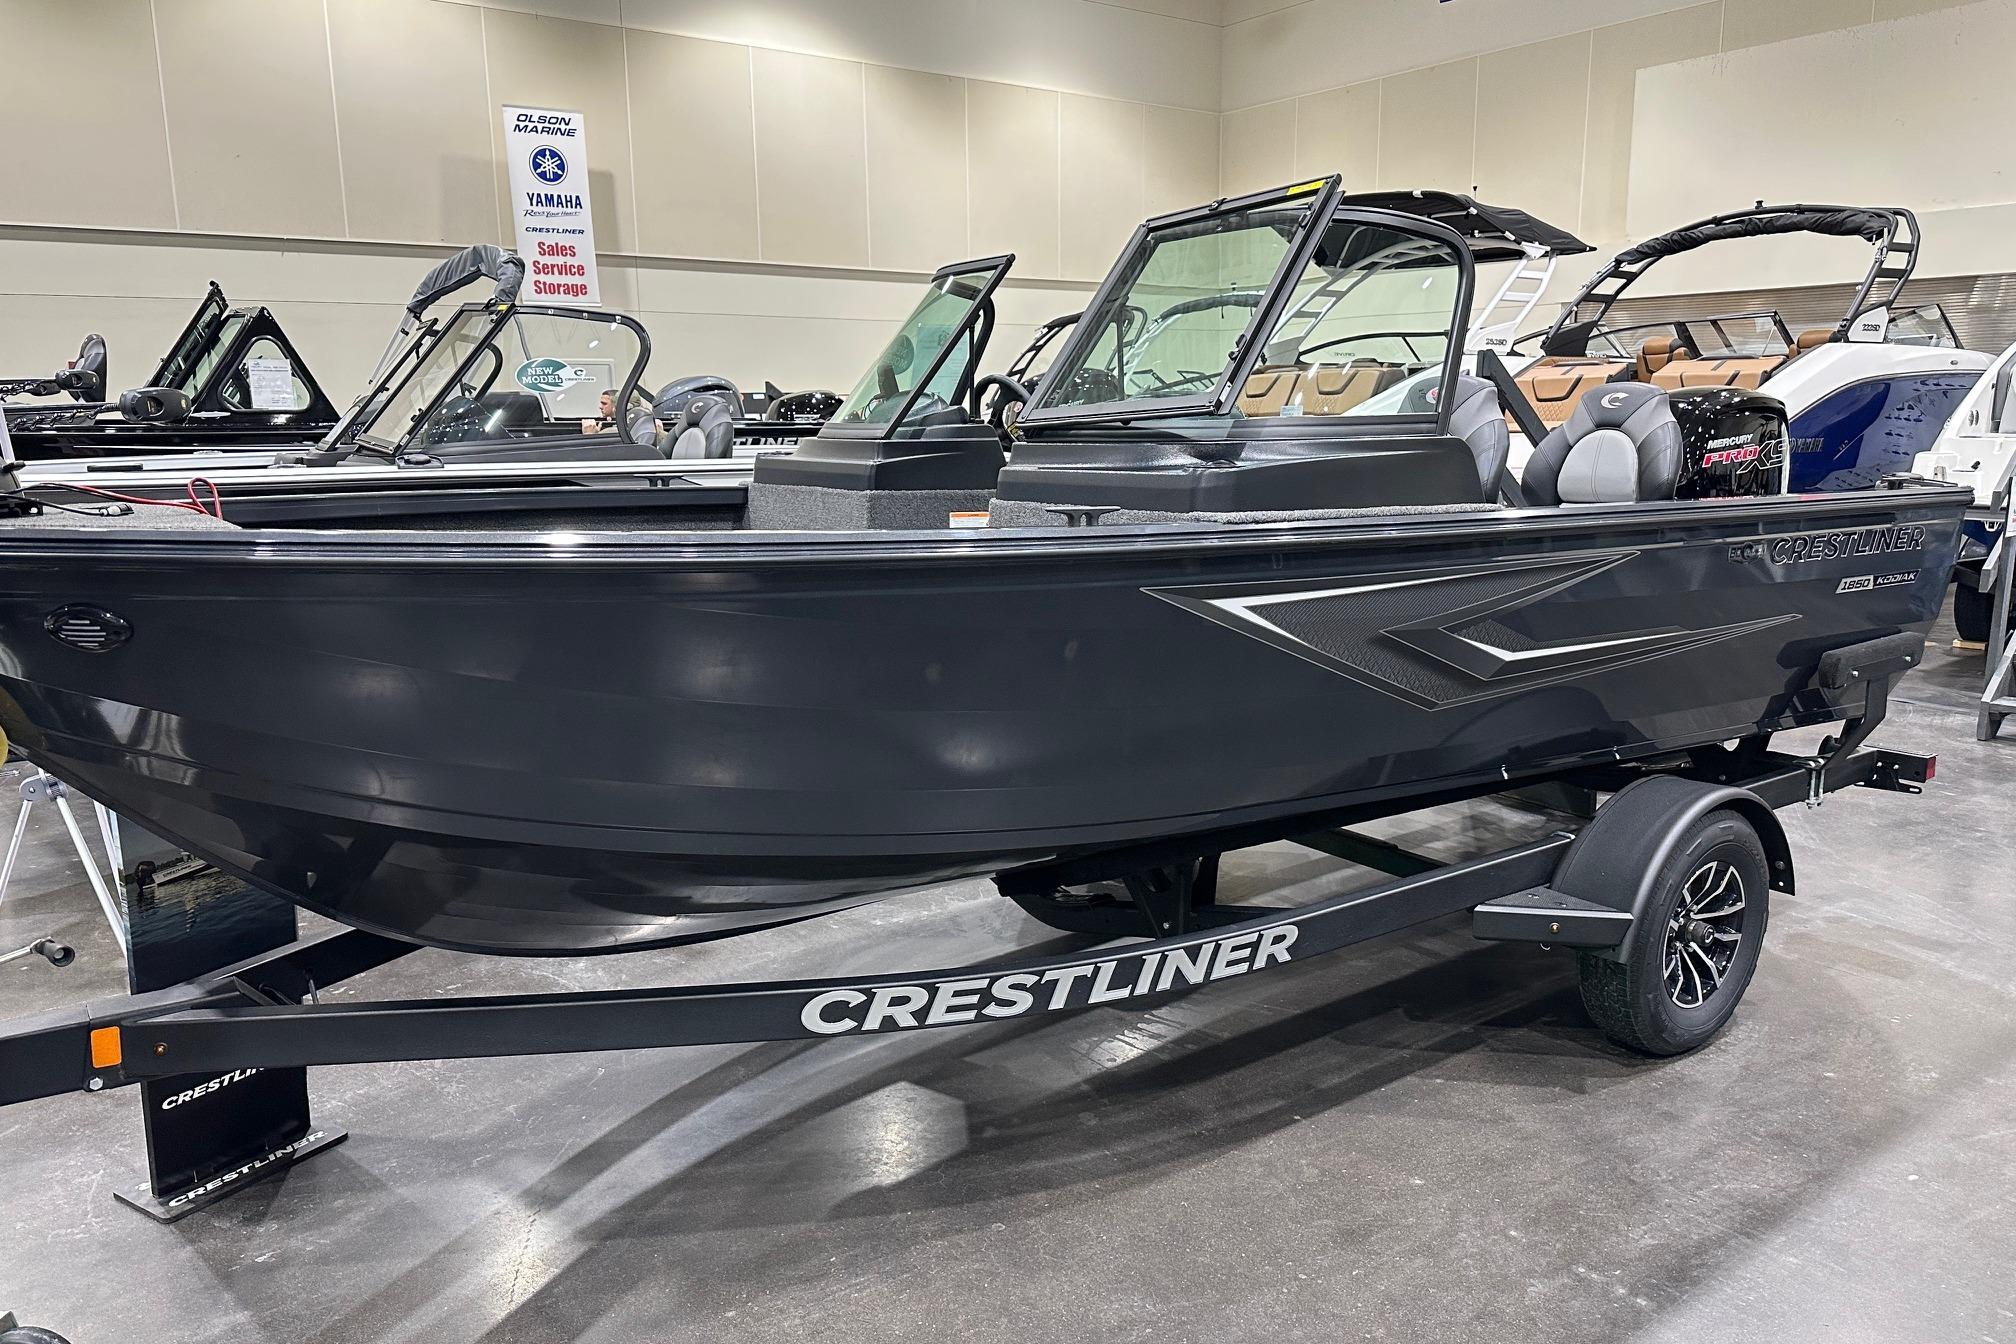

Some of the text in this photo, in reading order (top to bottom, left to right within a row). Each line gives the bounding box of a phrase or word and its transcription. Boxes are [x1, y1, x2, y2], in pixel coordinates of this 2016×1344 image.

[516, 113, 572, 127] OLSON
[513, 123, 577, 137] MARINE
[526, 192, 583, 209] YAMAHA
[525, 226, 585, 235] CRESTLINER
[537, 241, 576, 257] Sales
[532, 260, 585, 276] Service
[533, 280, 588, 297] Storage
[521, 374, 562, 384] MODEL
[527, 366, 554, 376] NEW
[1706, 433, 1754, 450] MERCURY
[1702, 438, 1786, 475] PRO XS
[1771, 525, 1926, 566] CRESTLINER
[1841, 572, 1916, 591] 1850 KODIAK
[800, 923, 1299, 1035] CRESTLINER
[168, 1129, 327, 1208] CRESTLINER
